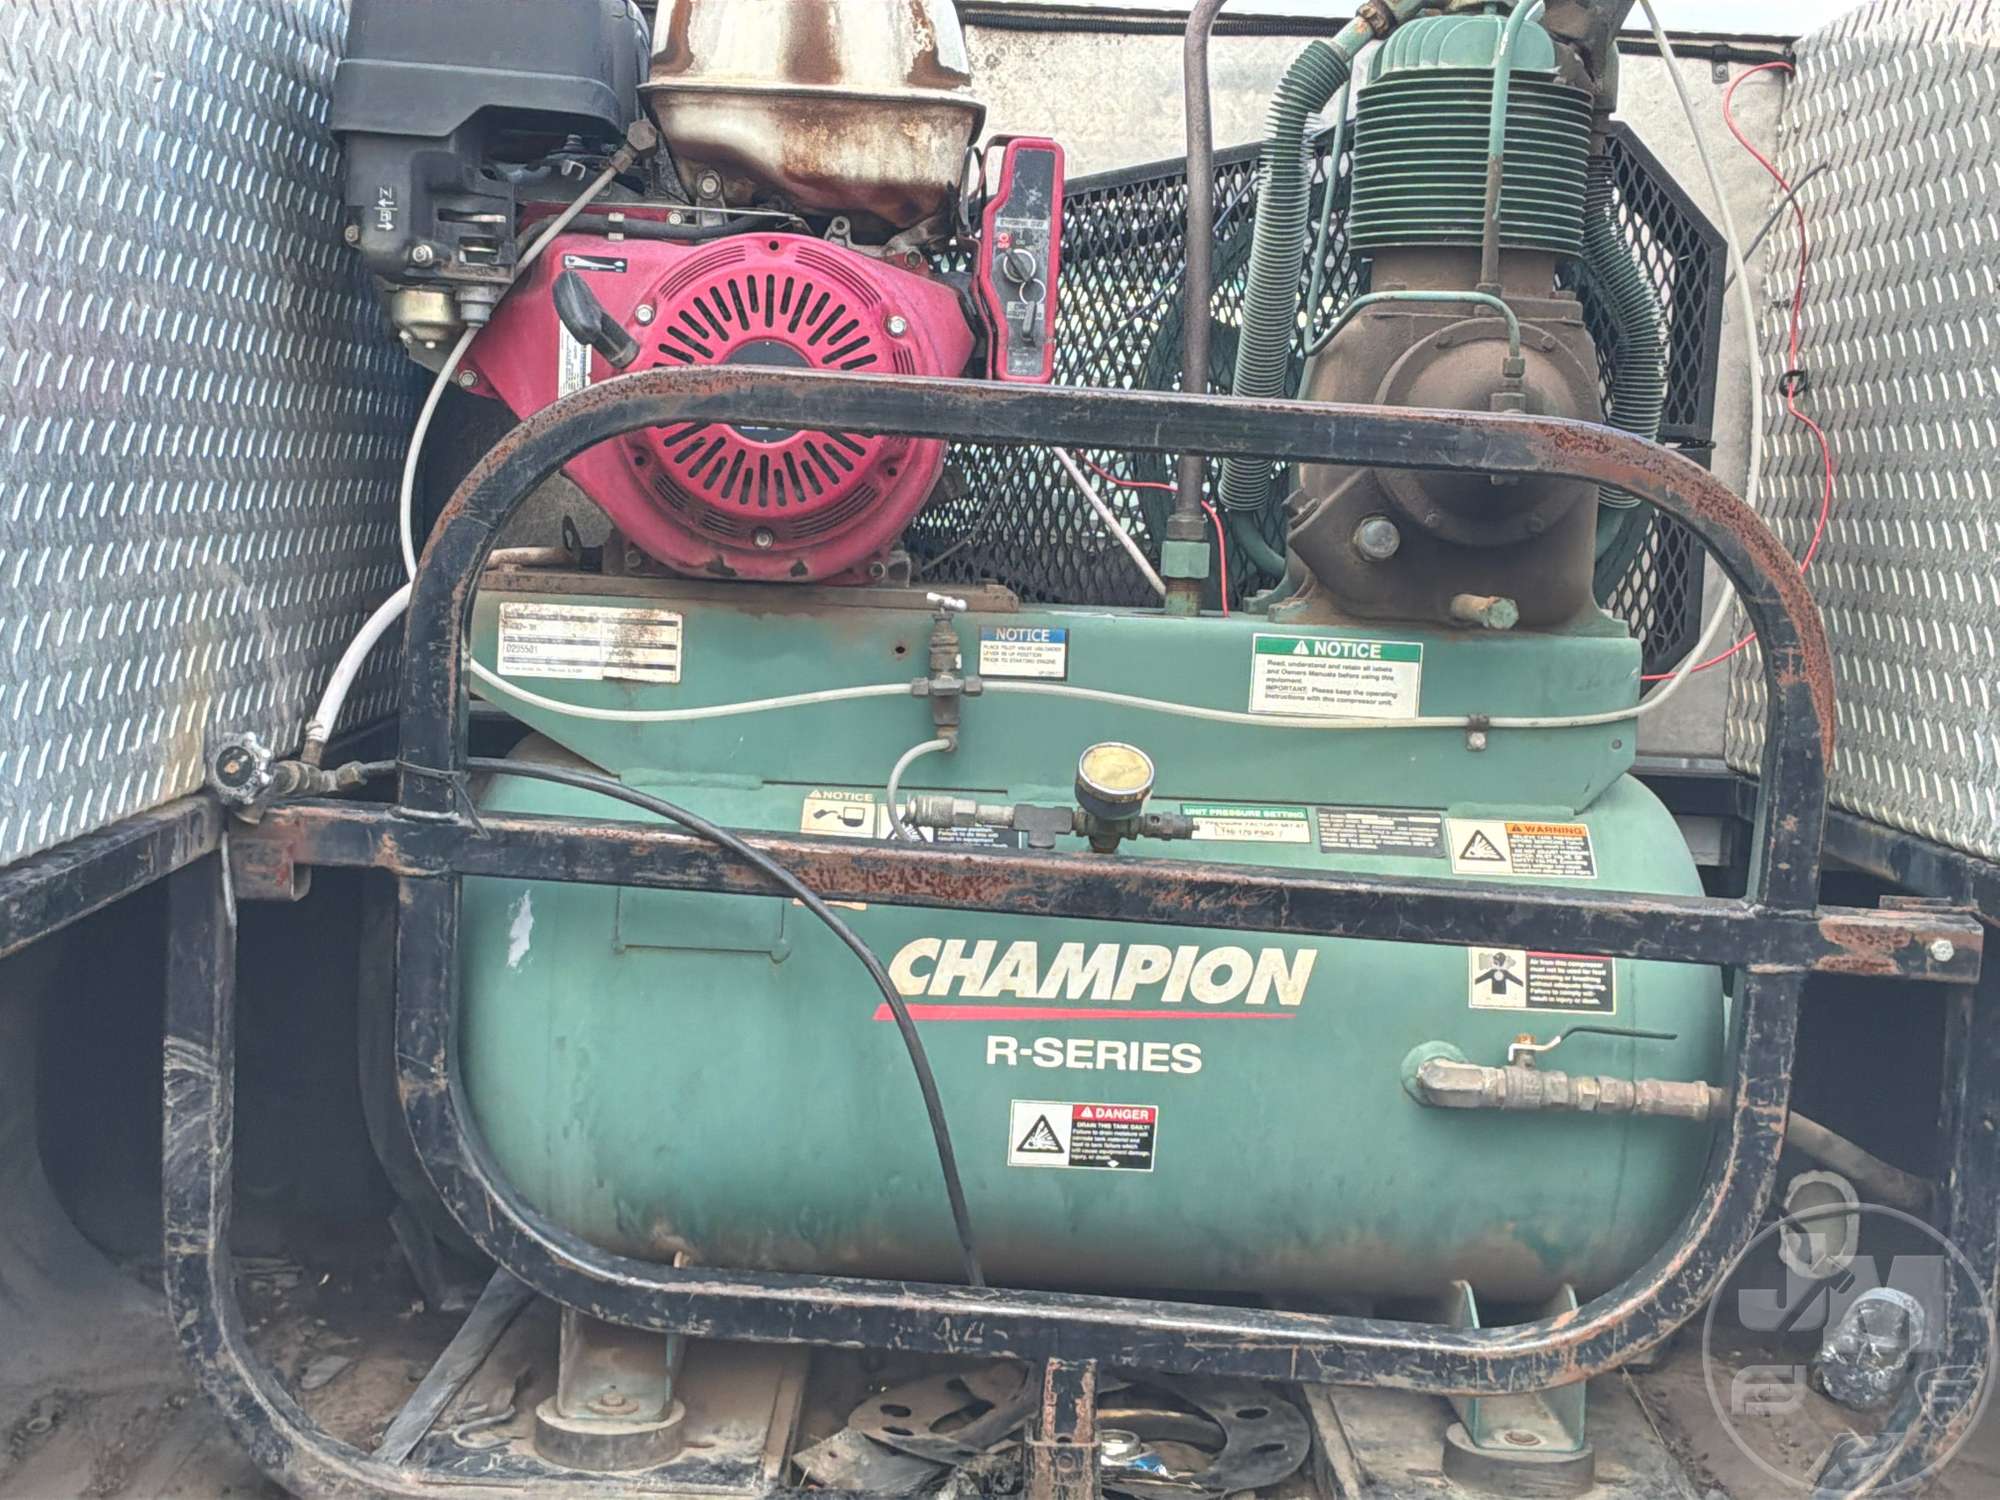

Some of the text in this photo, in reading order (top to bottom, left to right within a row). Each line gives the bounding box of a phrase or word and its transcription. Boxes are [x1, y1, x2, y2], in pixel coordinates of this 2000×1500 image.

[995, 628, 1050, 642] NOTICE
[1314, 641, 1382, 659] NOTICE
[823, 791, 874, 802] NOTICE
[1184, 808, 1305, 819] UNIT PRESSURE SETTING
[1525, 825, 1583, 835] WARNING
[888, 937, 1318, 1006] CHAMPION
[986, 1034, 1203, 1075] R-SERIES
[1095, 1108, 1149, 1120] DANGER
